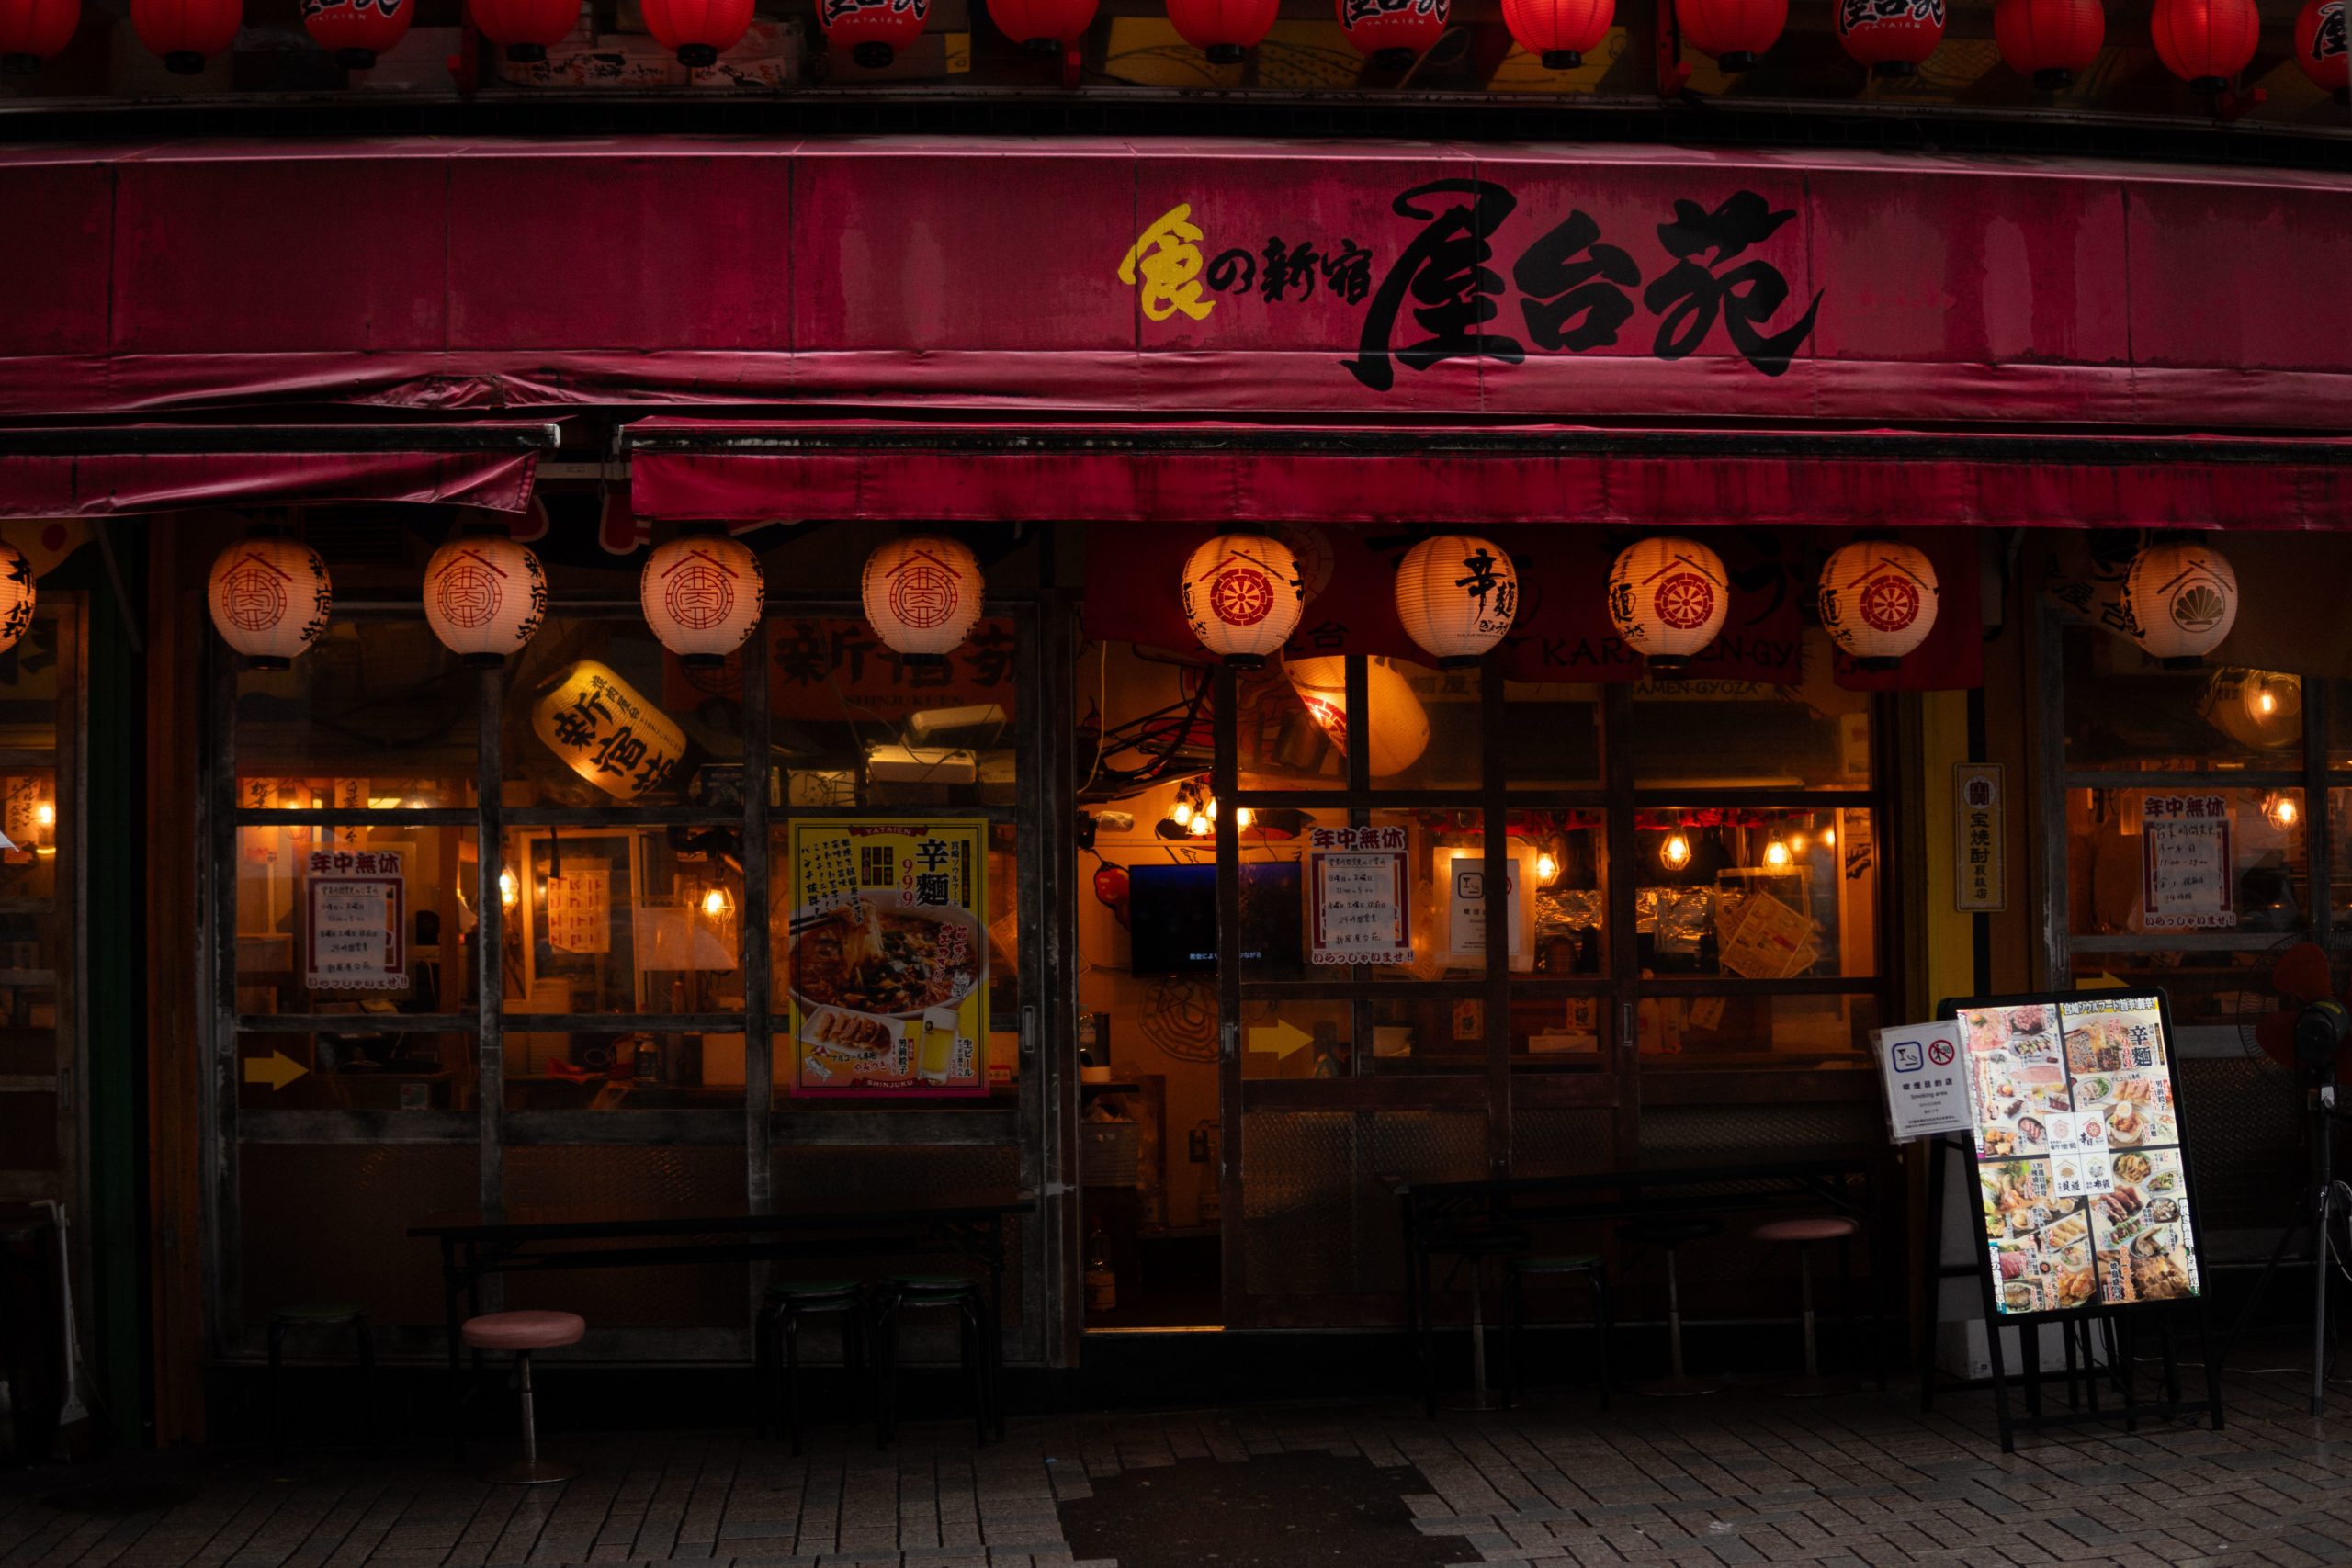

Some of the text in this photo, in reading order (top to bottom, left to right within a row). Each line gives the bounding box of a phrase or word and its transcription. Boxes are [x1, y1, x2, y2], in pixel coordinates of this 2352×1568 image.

[1340, 178, 1826, 392] 屋台苑
[2144, 796, 2225, 817] 年中無休
[865, 827, 912, 836] YATAIEN
[1313, 827, 1404, 849] 年中無休
[311, 852, 400, 874] 年中無休
[1969, 811, 1991, 899] 宝焼酎取扱店
[916, 839, 949, 907] 辛麺
[2130, 1025, 2153, 1067] 辛麺
[963, 1038, 974, 1077] 生ビール
[866, 1079, 914, 1089] SHINJUKU
[1902, 1077, 1953, 1091] 喫煙目的店
